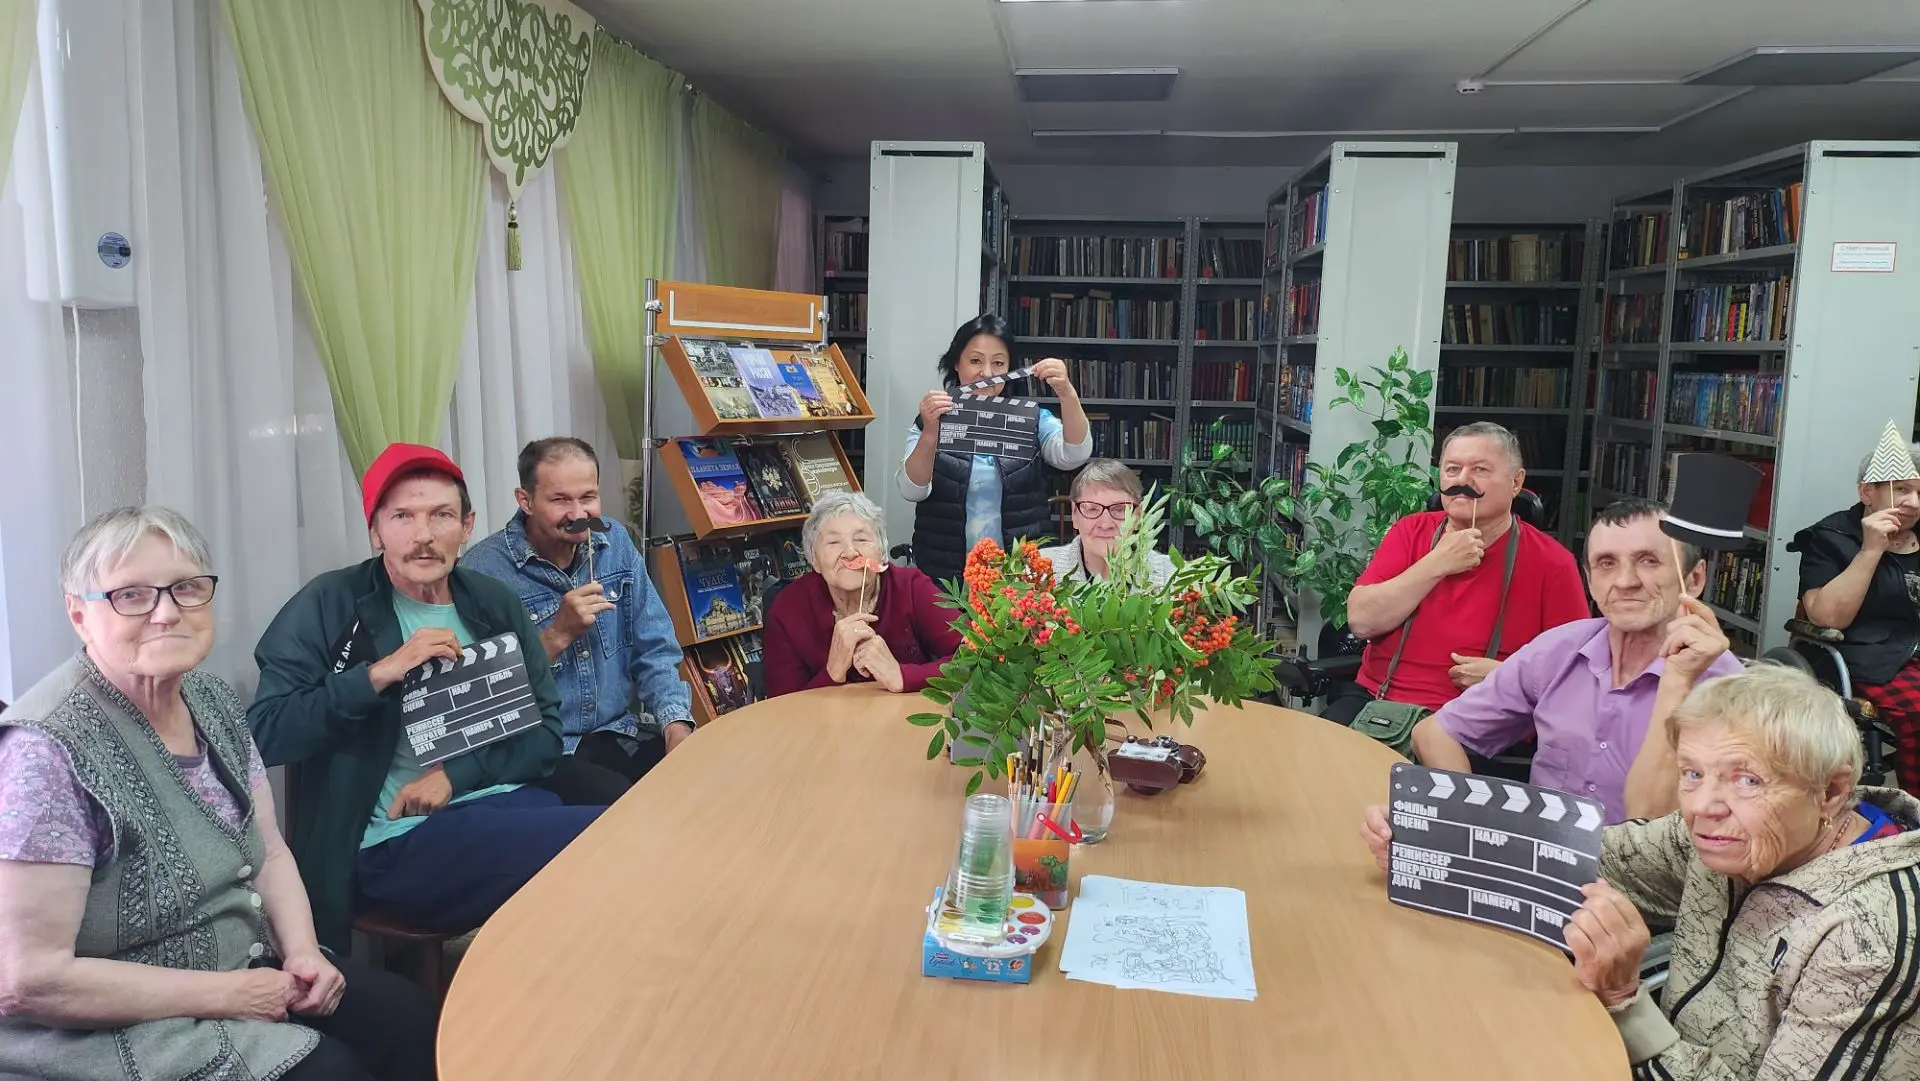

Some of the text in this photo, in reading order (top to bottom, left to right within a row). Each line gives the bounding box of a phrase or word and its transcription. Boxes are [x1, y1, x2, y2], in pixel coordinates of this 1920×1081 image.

[1393, 799, 1439, 819] ФИЛЬМ
[1393, 813, 1430, 832] СЦЕНА
[1391, 859, 1450, 881] ОПЕРАТОР
[1391, 873, 1422, 891] ДАТА
[986, 961, 1001, 971] 12
